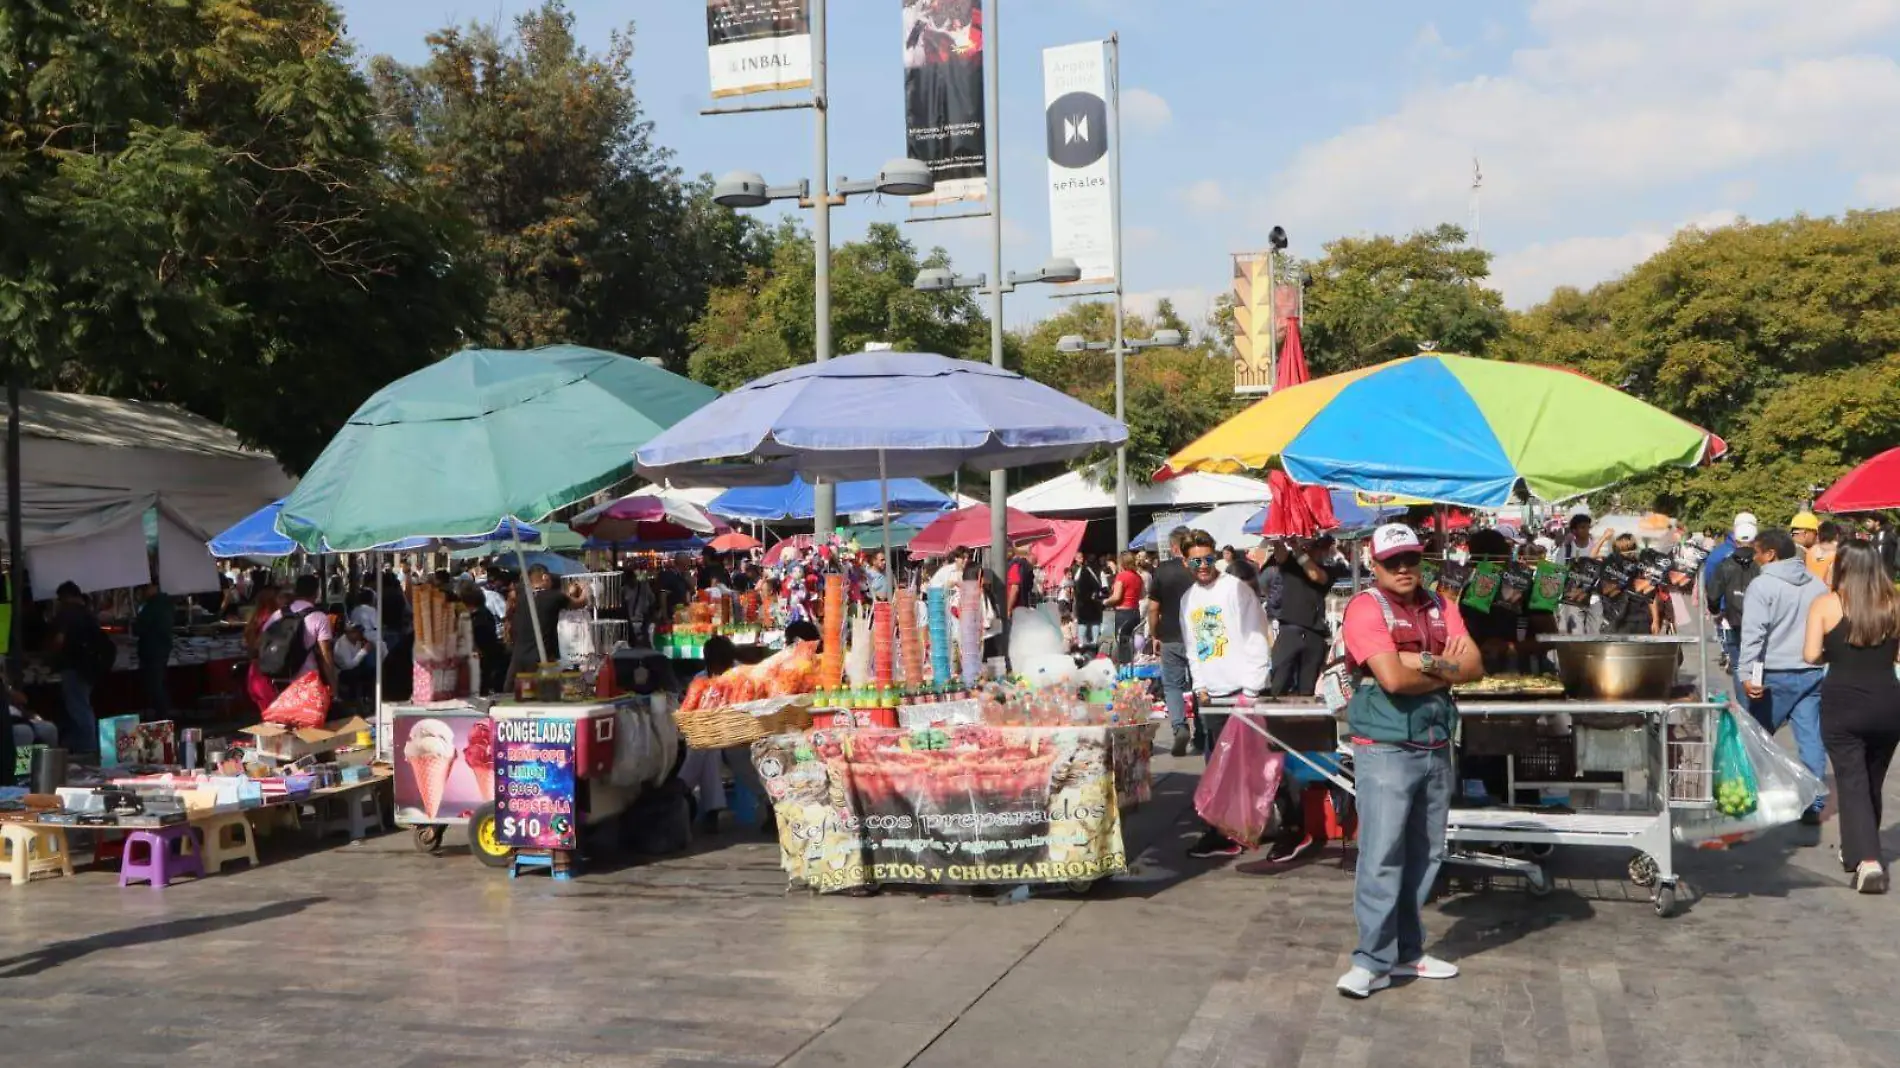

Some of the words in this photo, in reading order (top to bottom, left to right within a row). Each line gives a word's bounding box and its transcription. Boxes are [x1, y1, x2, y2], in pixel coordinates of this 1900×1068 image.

[741, 53, 792, 71] INBAL
[1053, 176, 1105, 191] señales
[497, 721, 571, 743] CONGELADAS
[508, 781, 540, 796] COCO
[508, 798, 571, 814] GROSELLA
[503, 816, 540, 838] $10
[931, 868, 943, 883] y
[949, 851, 1125, 881] CHICHARRONES
